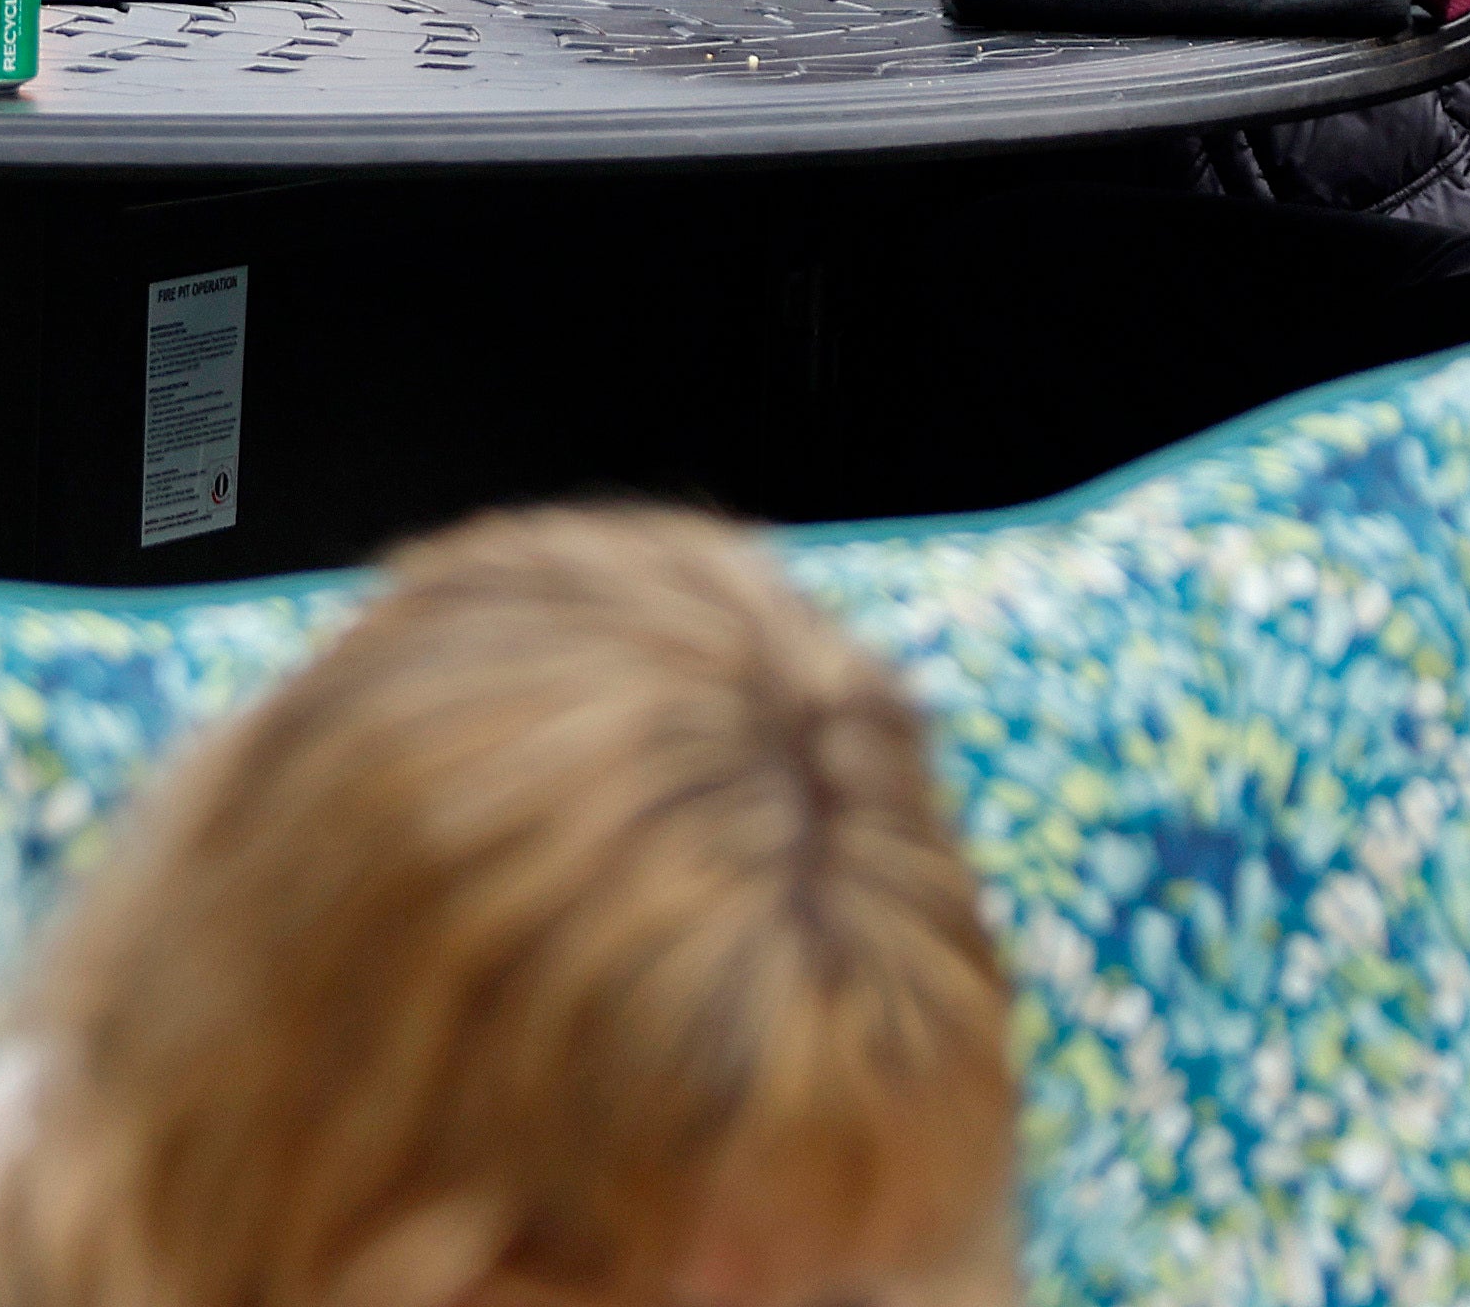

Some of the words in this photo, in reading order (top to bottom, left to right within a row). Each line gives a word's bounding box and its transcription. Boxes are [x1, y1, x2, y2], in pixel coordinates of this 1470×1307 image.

[157, 287, 176, 303] FIRE
[178, 284, 191, 298] PIT
[192, 274, 238, 297] OPERATION
